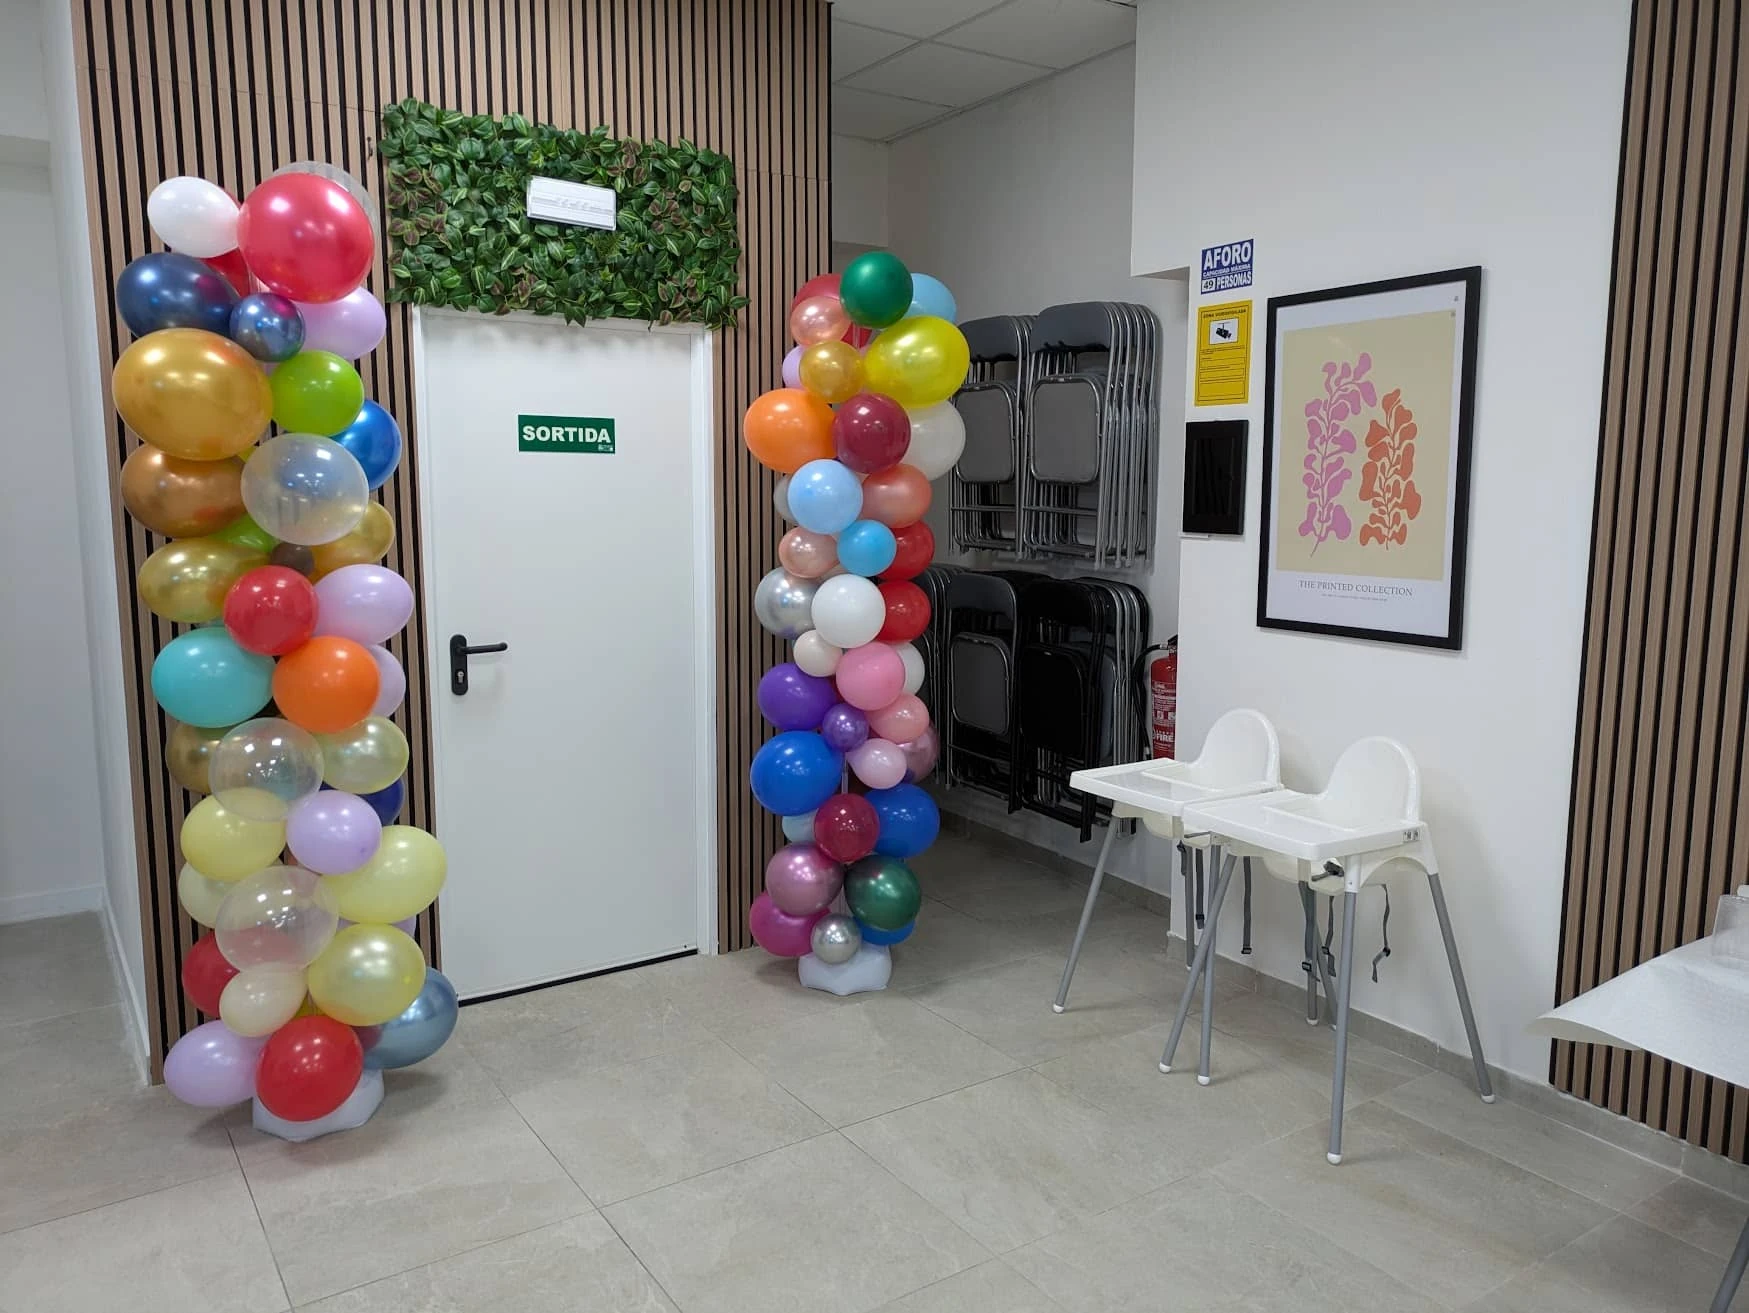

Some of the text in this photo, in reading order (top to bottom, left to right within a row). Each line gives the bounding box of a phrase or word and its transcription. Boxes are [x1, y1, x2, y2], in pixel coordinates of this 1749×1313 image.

[1203, 241, 1252, 271] AFORO
[1203, 271, 1251, 290] 49 PERSONAS
[522, 425, 611, 443] SORTIDA
[1300, 580, 1413, 596] THE PRINTED COLLECTION
